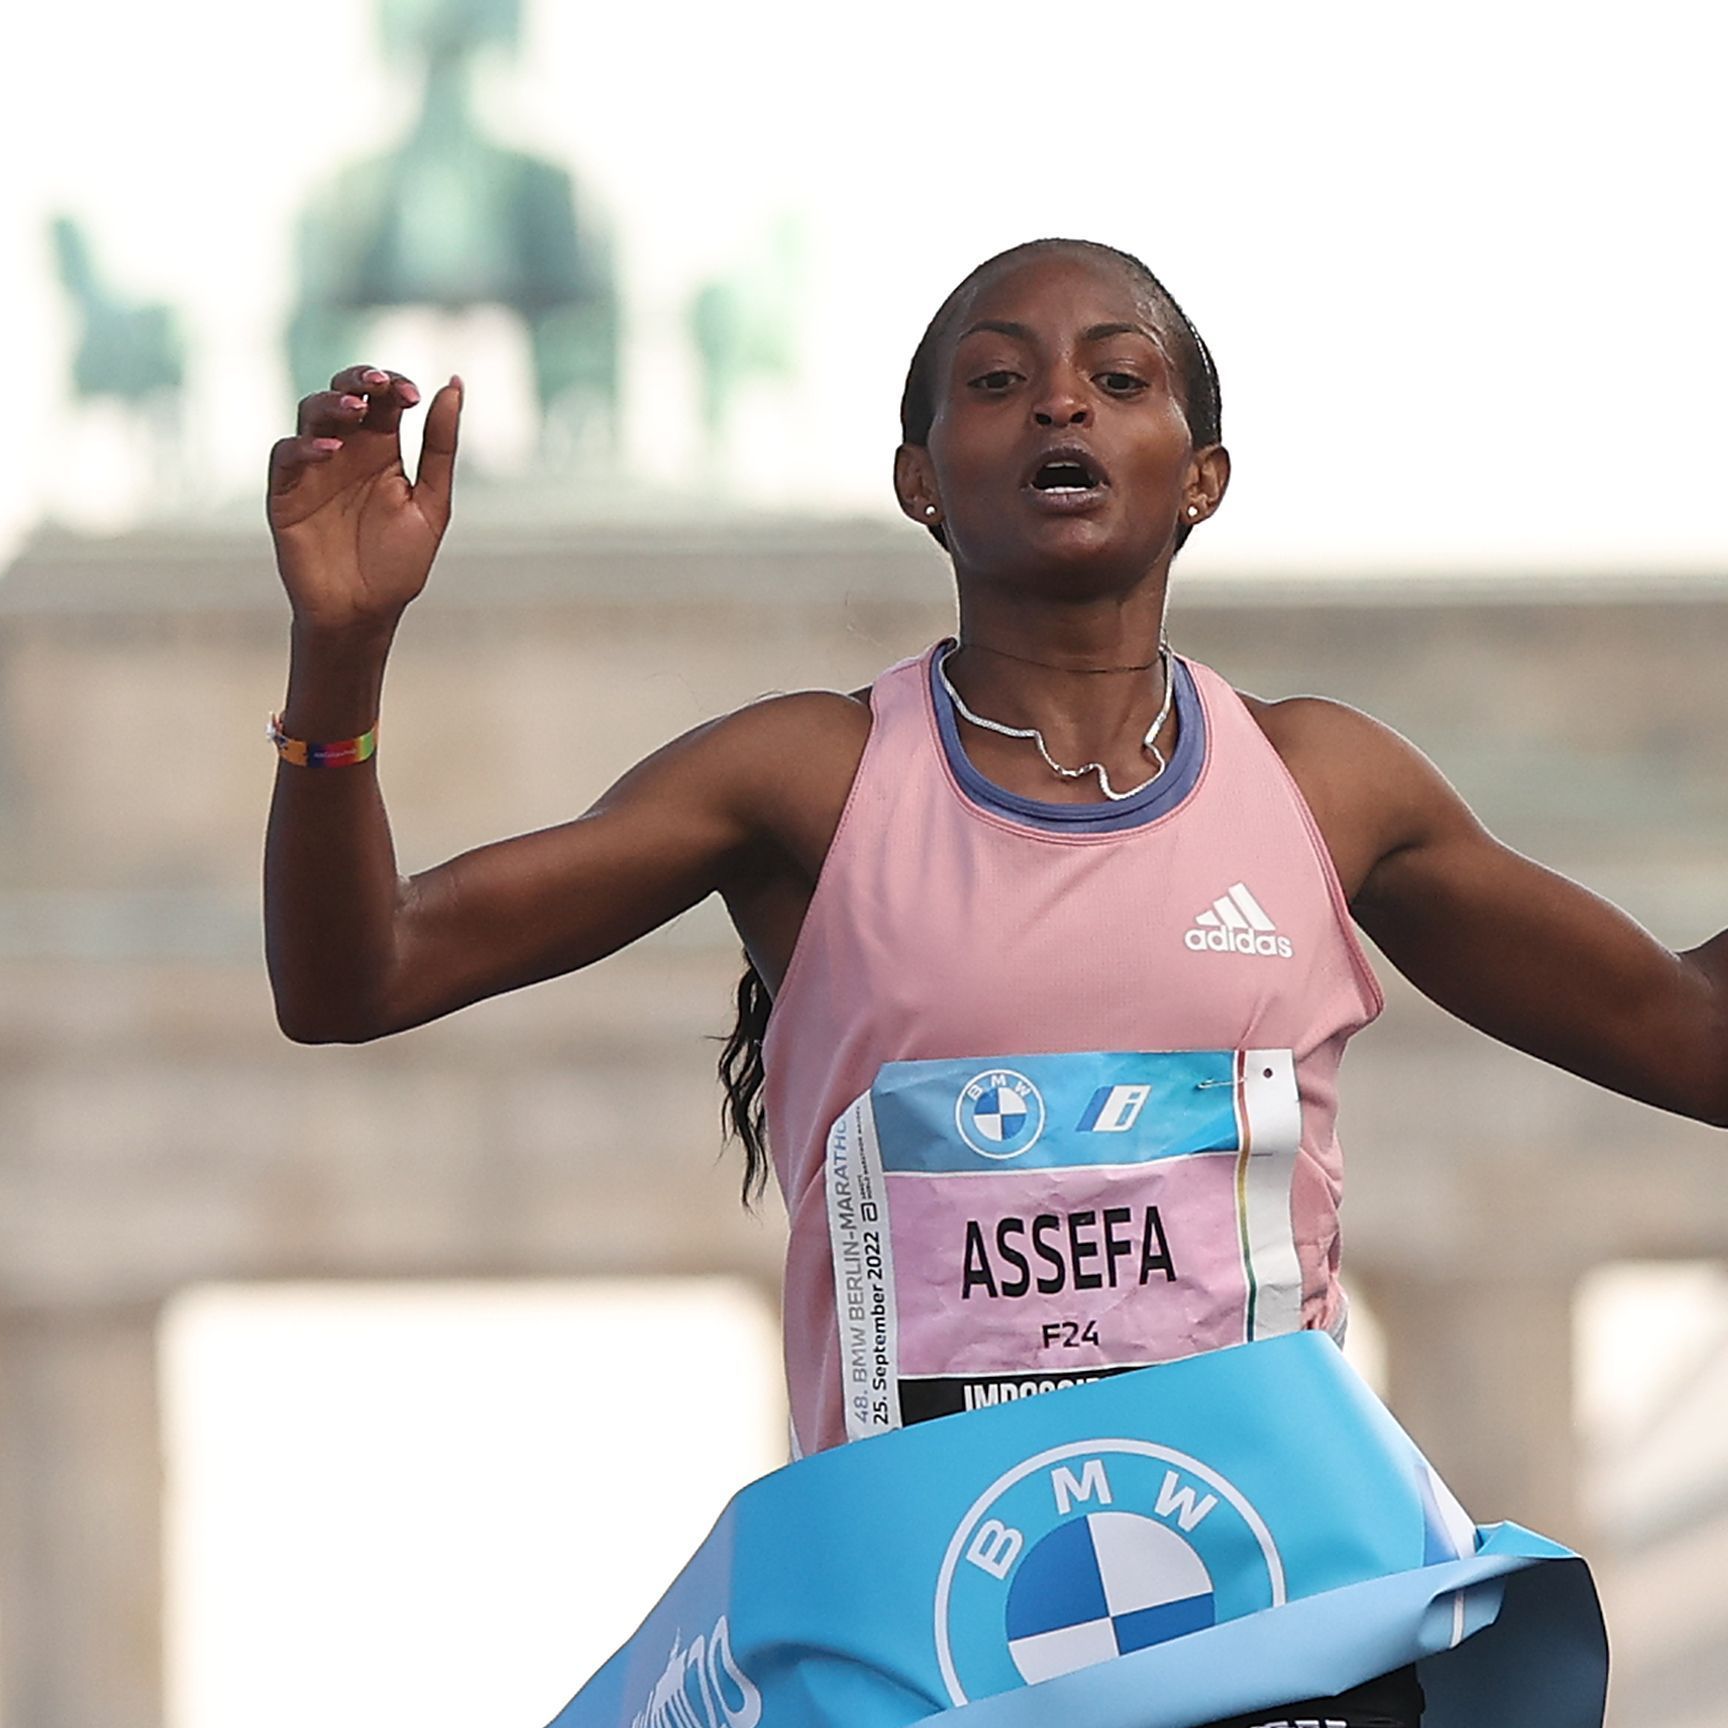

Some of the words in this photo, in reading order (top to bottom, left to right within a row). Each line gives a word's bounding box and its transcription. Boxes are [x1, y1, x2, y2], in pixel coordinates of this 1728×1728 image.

[1183, 924, 1294, 958] adidas
[968, 1074, 1032, 1101] BMW
[863, 1231, 883, 1281] 2022
[961, 1205, 1177, 1300] ASSEFA
[849, 1326, 868, 1383] BMW
[870, 1283, 890, 1391] September
[1041, 1320, 1100, 1349] F24
[873, 1396, 888, 1425] 25.
[965, 1458, 1219, 1581] BMW
